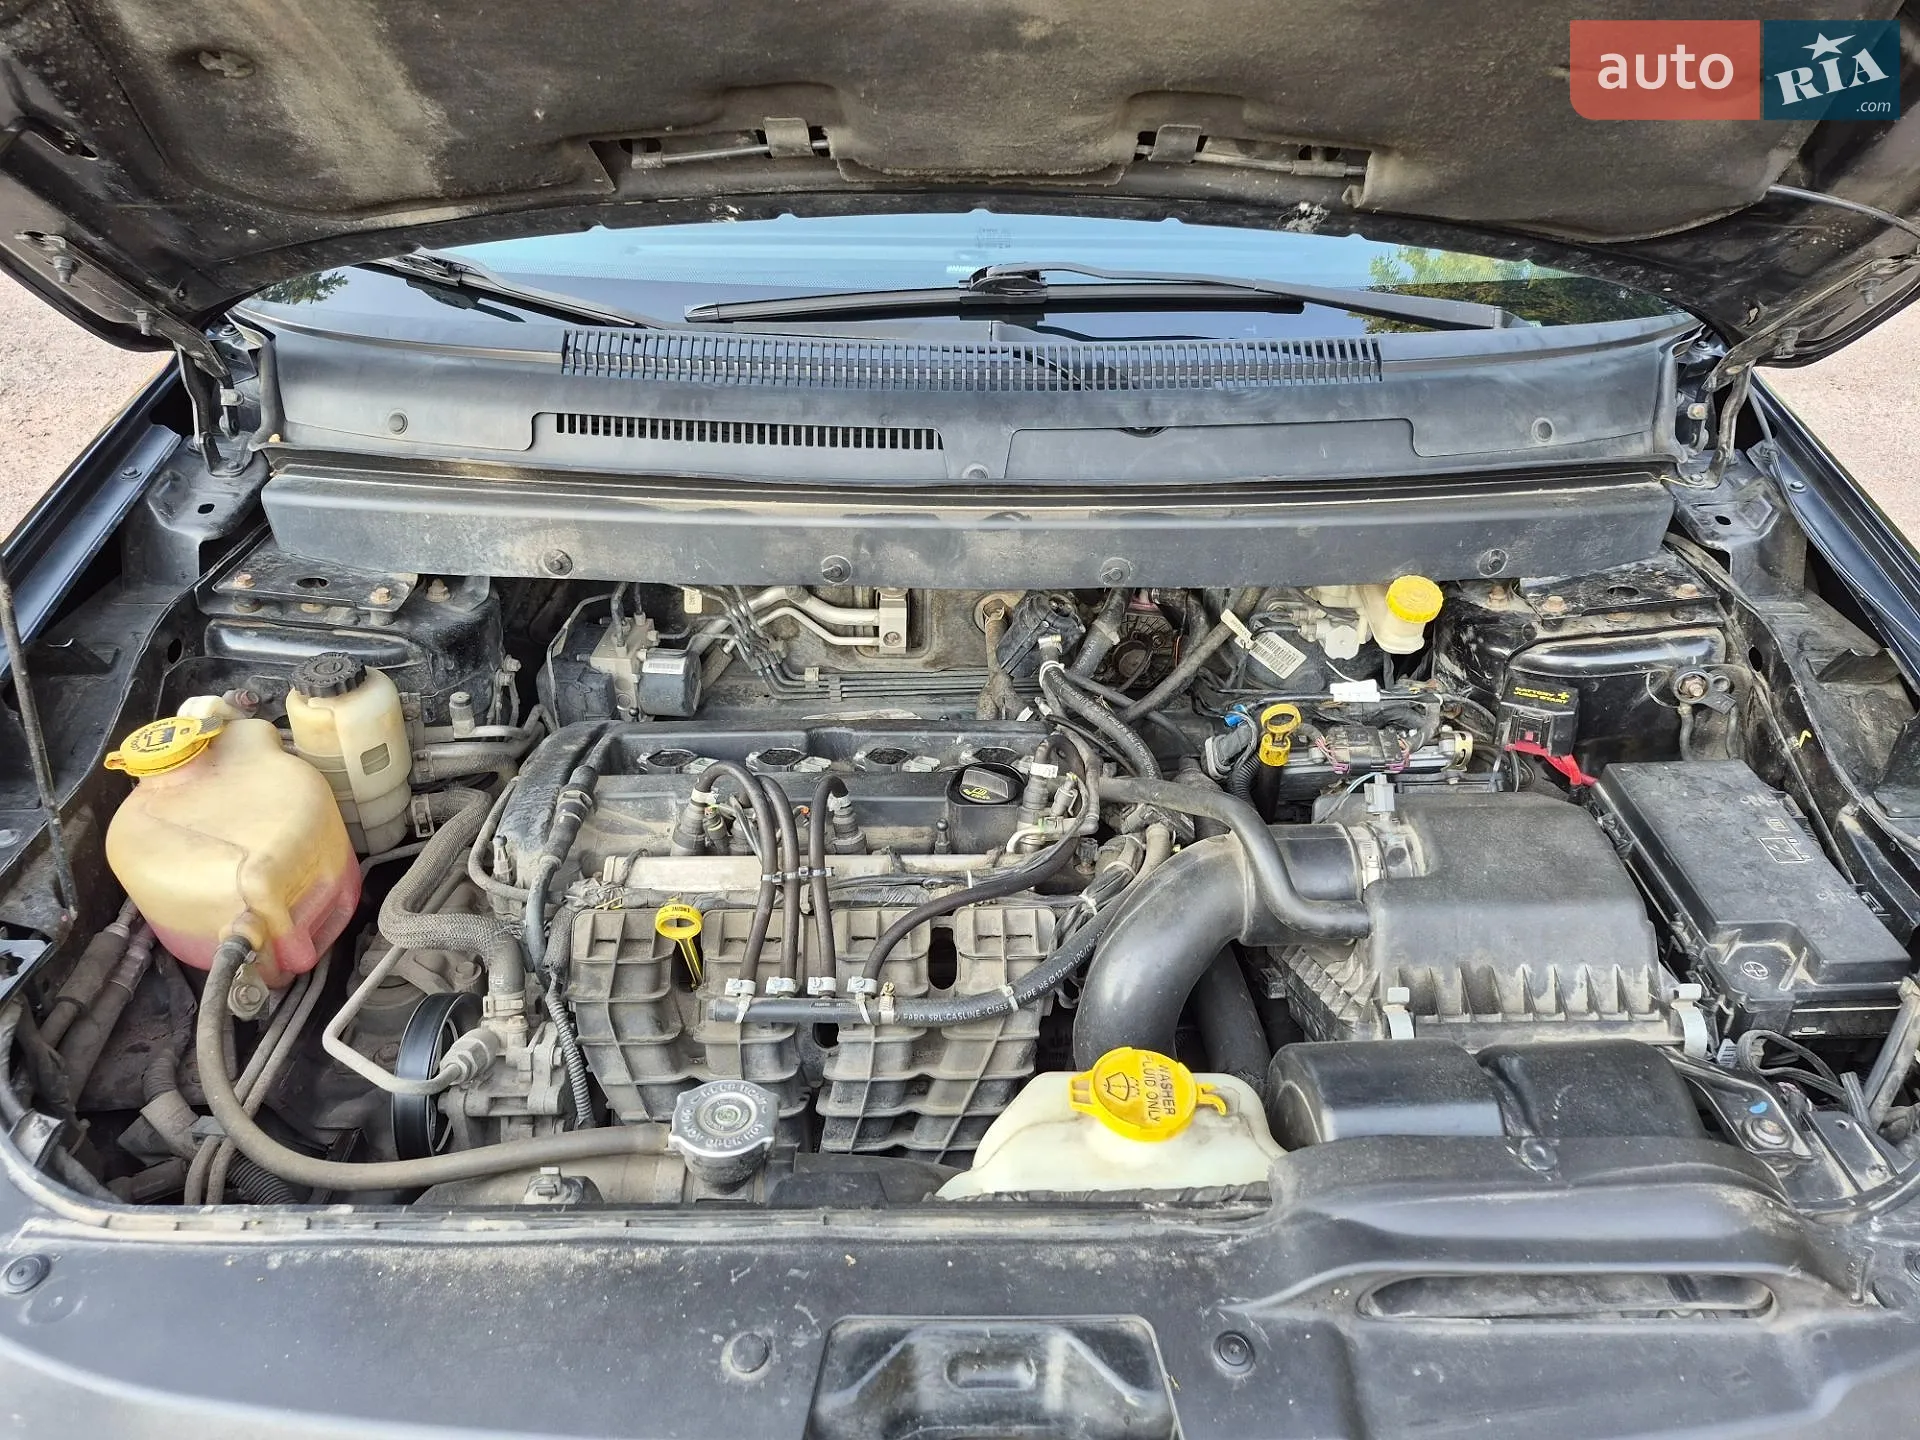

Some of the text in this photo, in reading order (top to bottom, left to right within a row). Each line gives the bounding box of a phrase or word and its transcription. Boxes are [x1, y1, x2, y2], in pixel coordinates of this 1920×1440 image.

[1018, 988, 1037, 1001] TYPE
[1159, 1064, 1176, 1116] WASHER
[1145, 1091, 1161, 1123] ONLY
